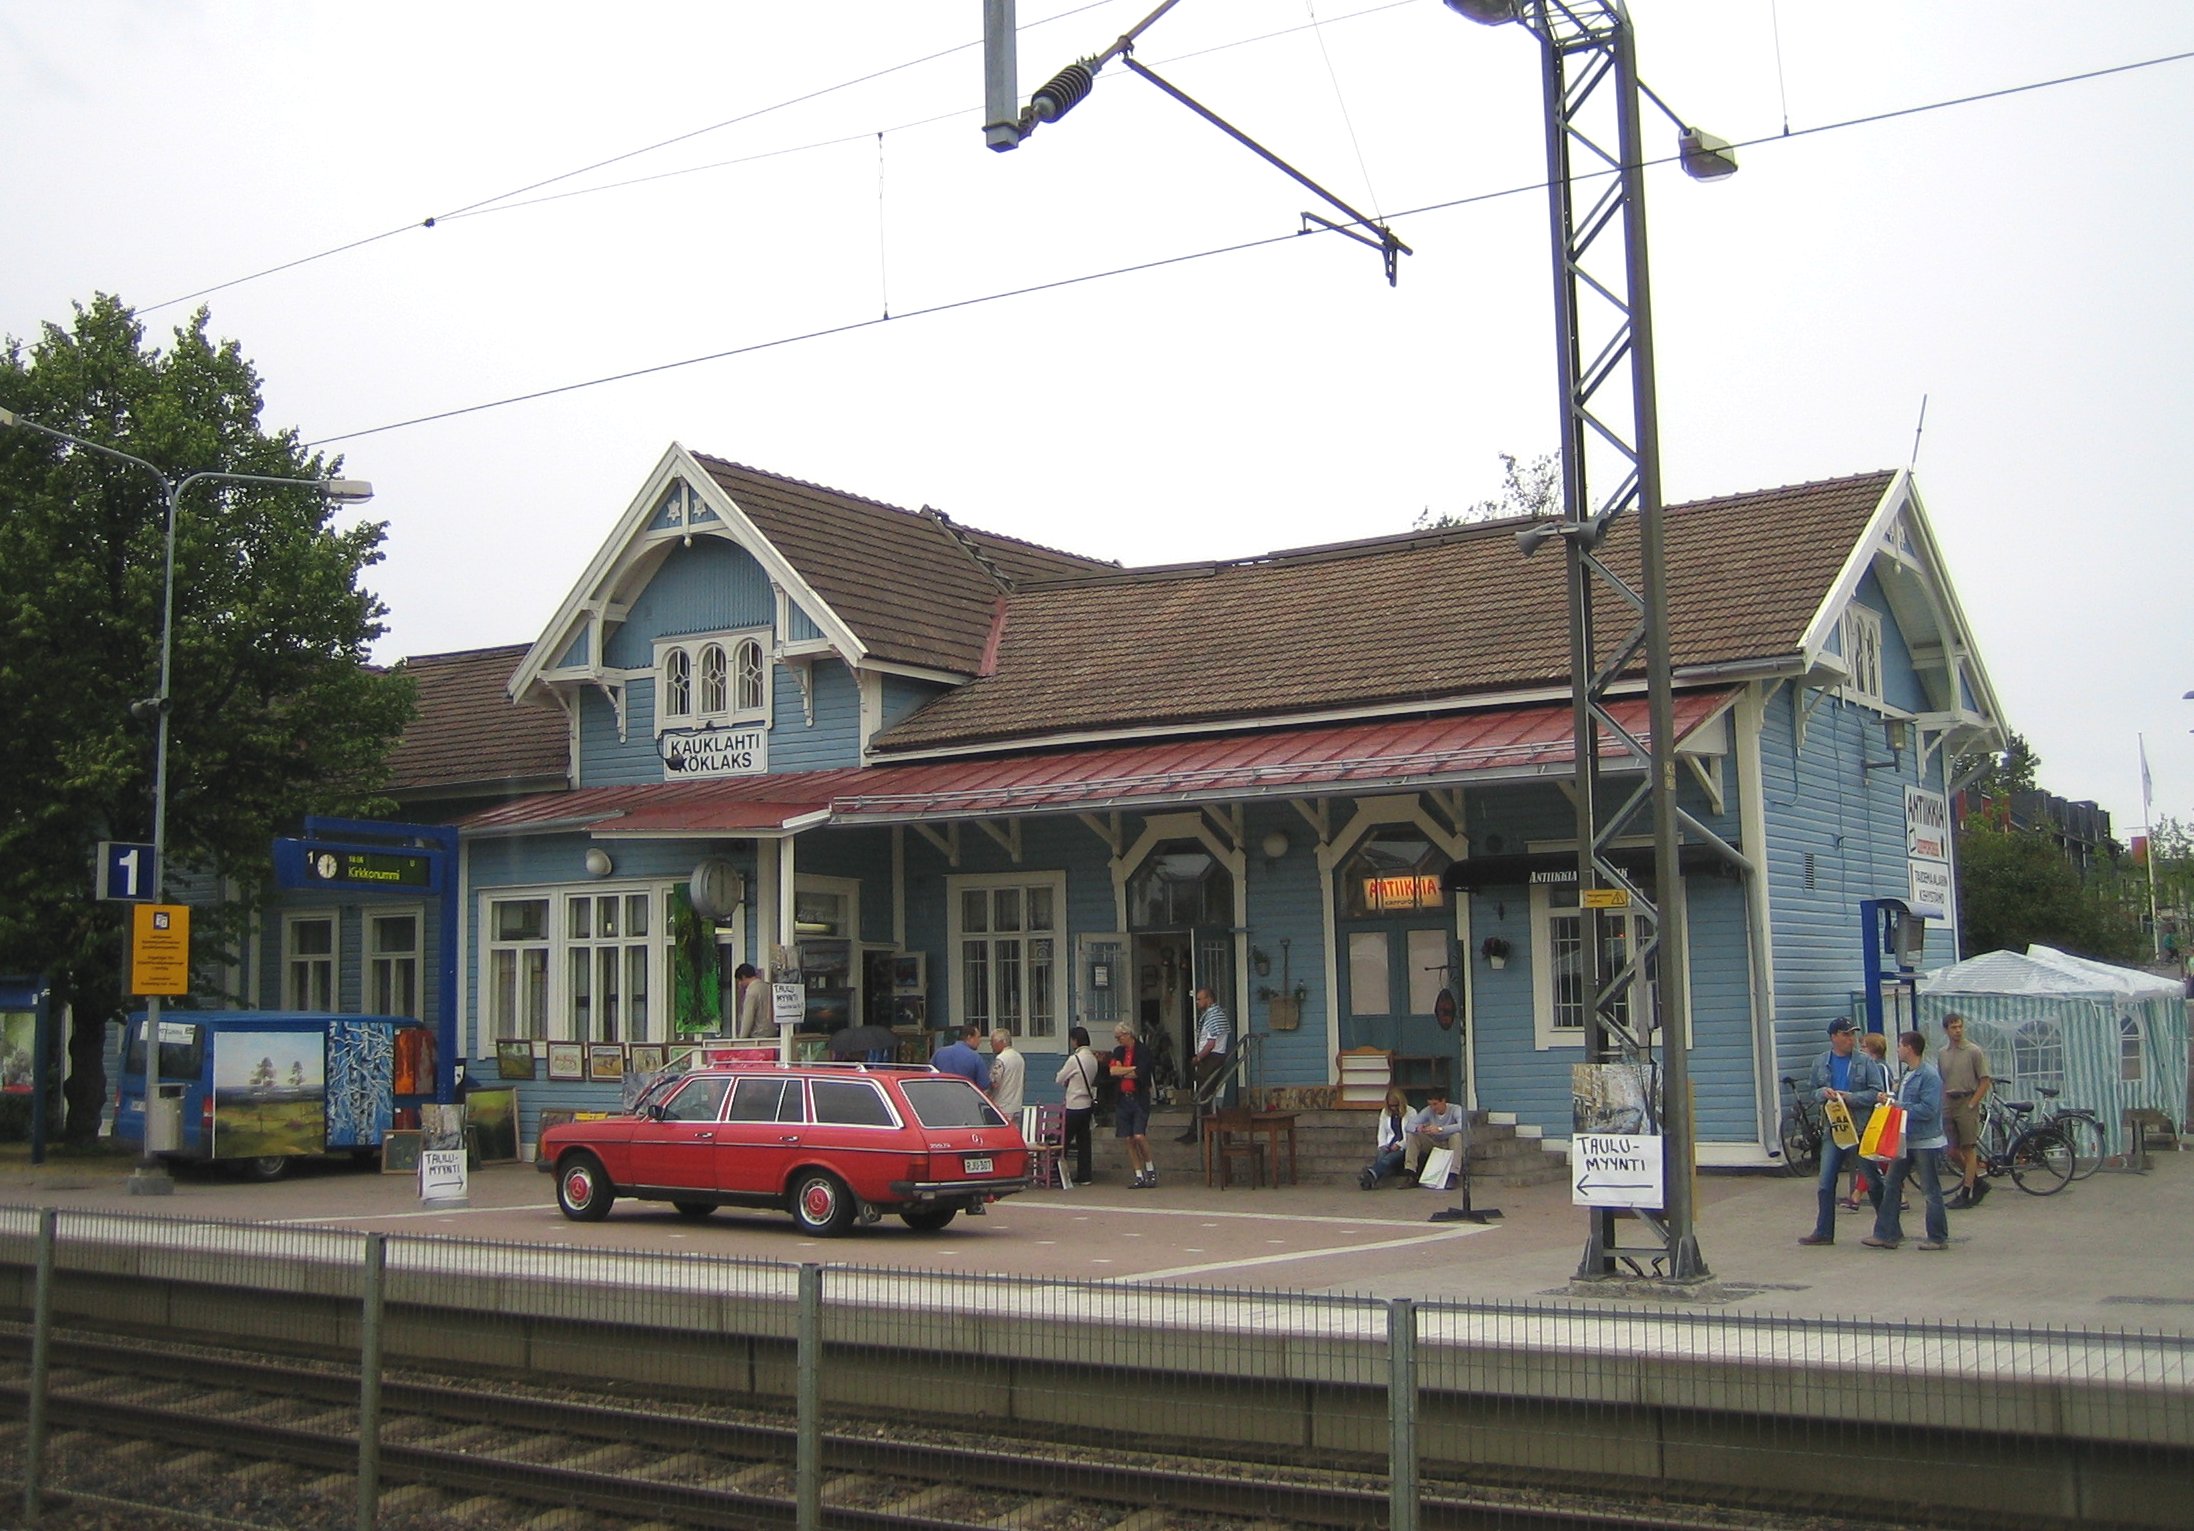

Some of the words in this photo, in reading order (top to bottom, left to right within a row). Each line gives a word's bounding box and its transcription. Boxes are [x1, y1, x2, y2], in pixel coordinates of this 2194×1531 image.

[671, 733, 760, 758] KAUKLAHTI
[307, 851, 314, 864] 1
[118, 849, 139, 896] 1
[347, 866, 400, 881] Kirkkonummi
[1528, 871, 1578, 884] ANTIIKKIA
[1576, 1136, 1640, 1155] TAULU-
[1585, 1157, 1646, 1172] MYYNTI
